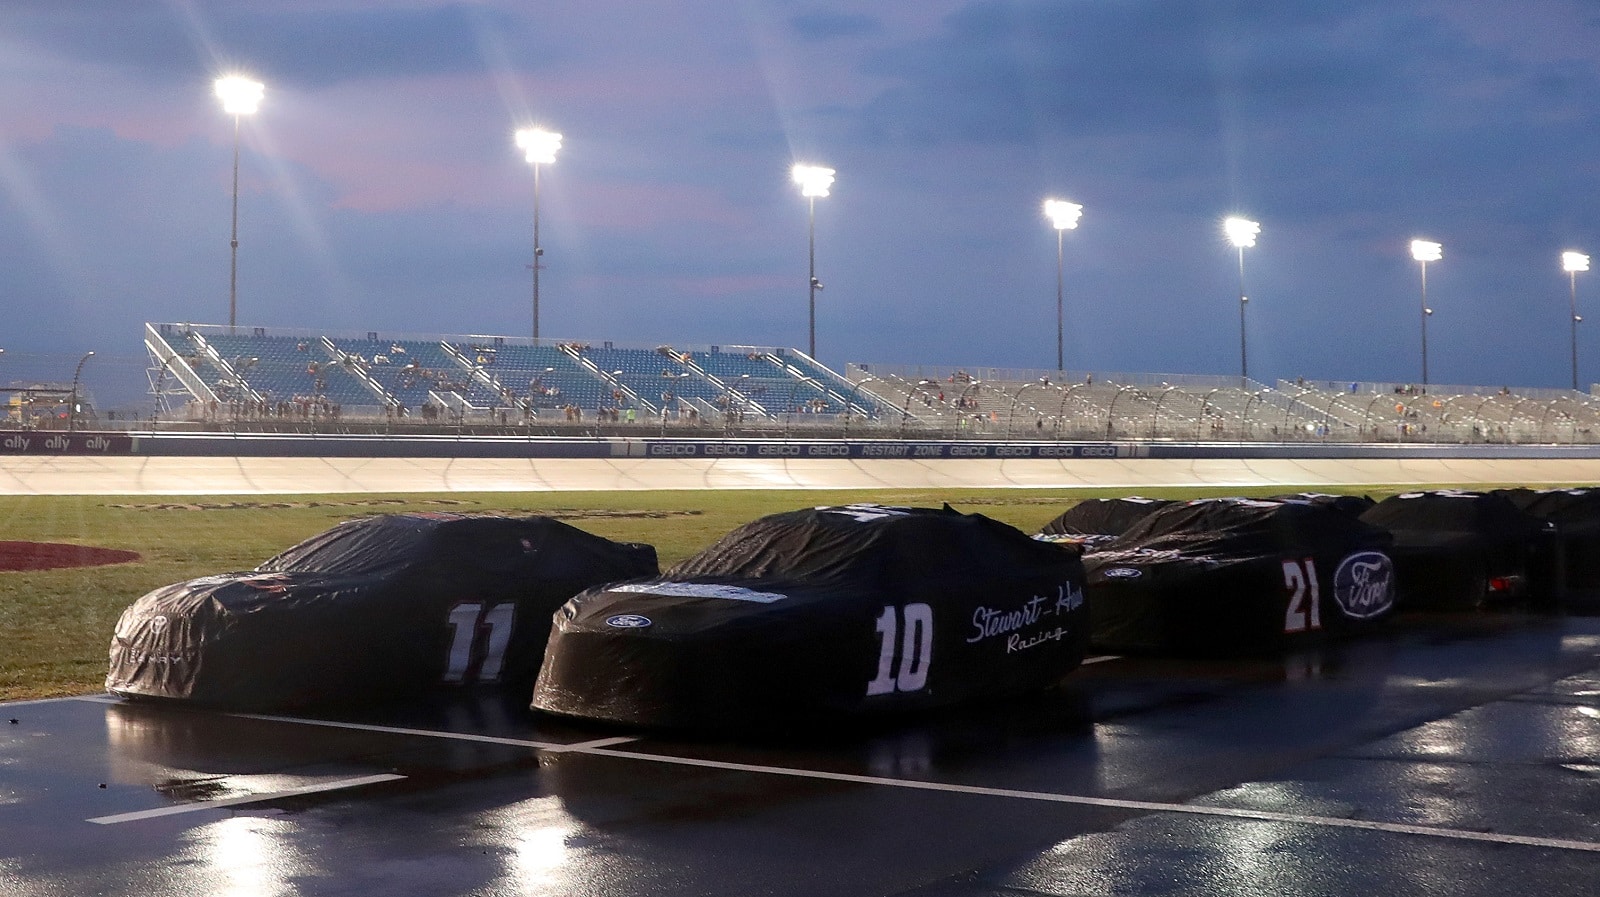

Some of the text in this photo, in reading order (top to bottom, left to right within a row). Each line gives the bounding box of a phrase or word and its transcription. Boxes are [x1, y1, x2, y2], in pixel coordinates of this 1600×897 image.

[5, 435, 110, 451] ally ally ally
[651, 445, 1115, 457] GEICO GEICO GEICO GEICO RESTART ZONE GEICO GEICO GEICO GEICO
[1282, 559, 1321, 631] 21
[1349, 561, 1390, 607] Ford
[443, 602, 515, 681] 11
[866, 602, 933, 696] 10
[1007, 626, 1068, 655] Racing
